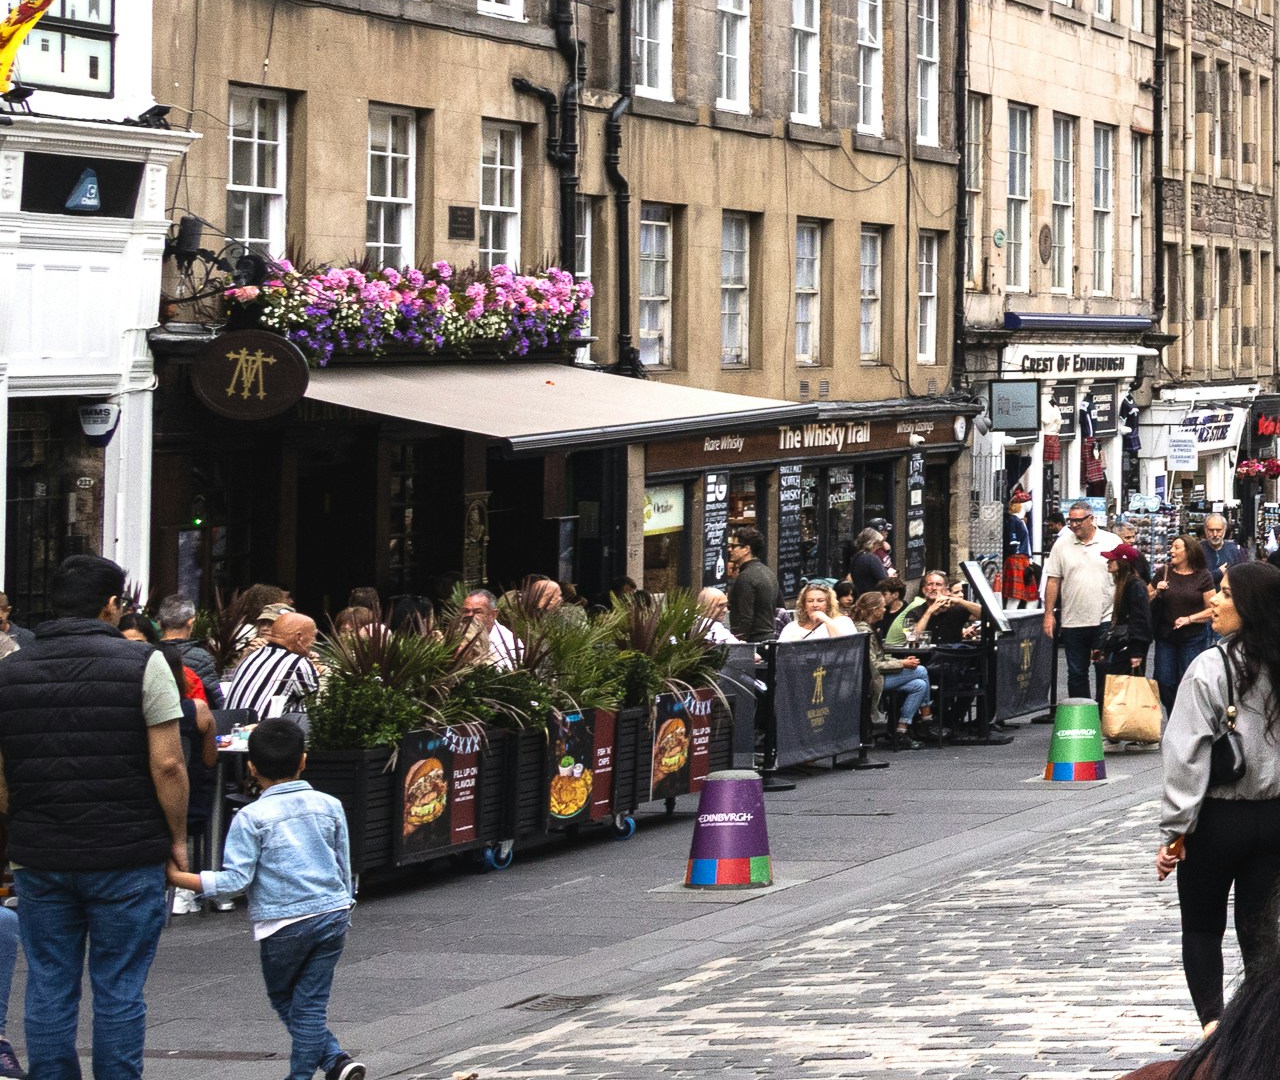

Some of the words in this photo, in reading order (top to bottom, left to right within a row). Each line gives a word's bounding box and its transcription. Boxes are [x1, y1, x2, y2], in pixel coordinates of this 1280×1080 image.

[1021, 355, 1054, 373] CREST
[1057, 354, 1070, 372] OF
[1073, 354, 1125, 373] EDINBURGH
[704, 437, 720, 451] Rare
[720, 434, 744, 452] Whisky
[779, 426, 801, 450] The
[803, 423, 845, 451] Whisky
[847, 420, 871, 444] Trail
[455, 778, 476, 789] FLAVOUR
